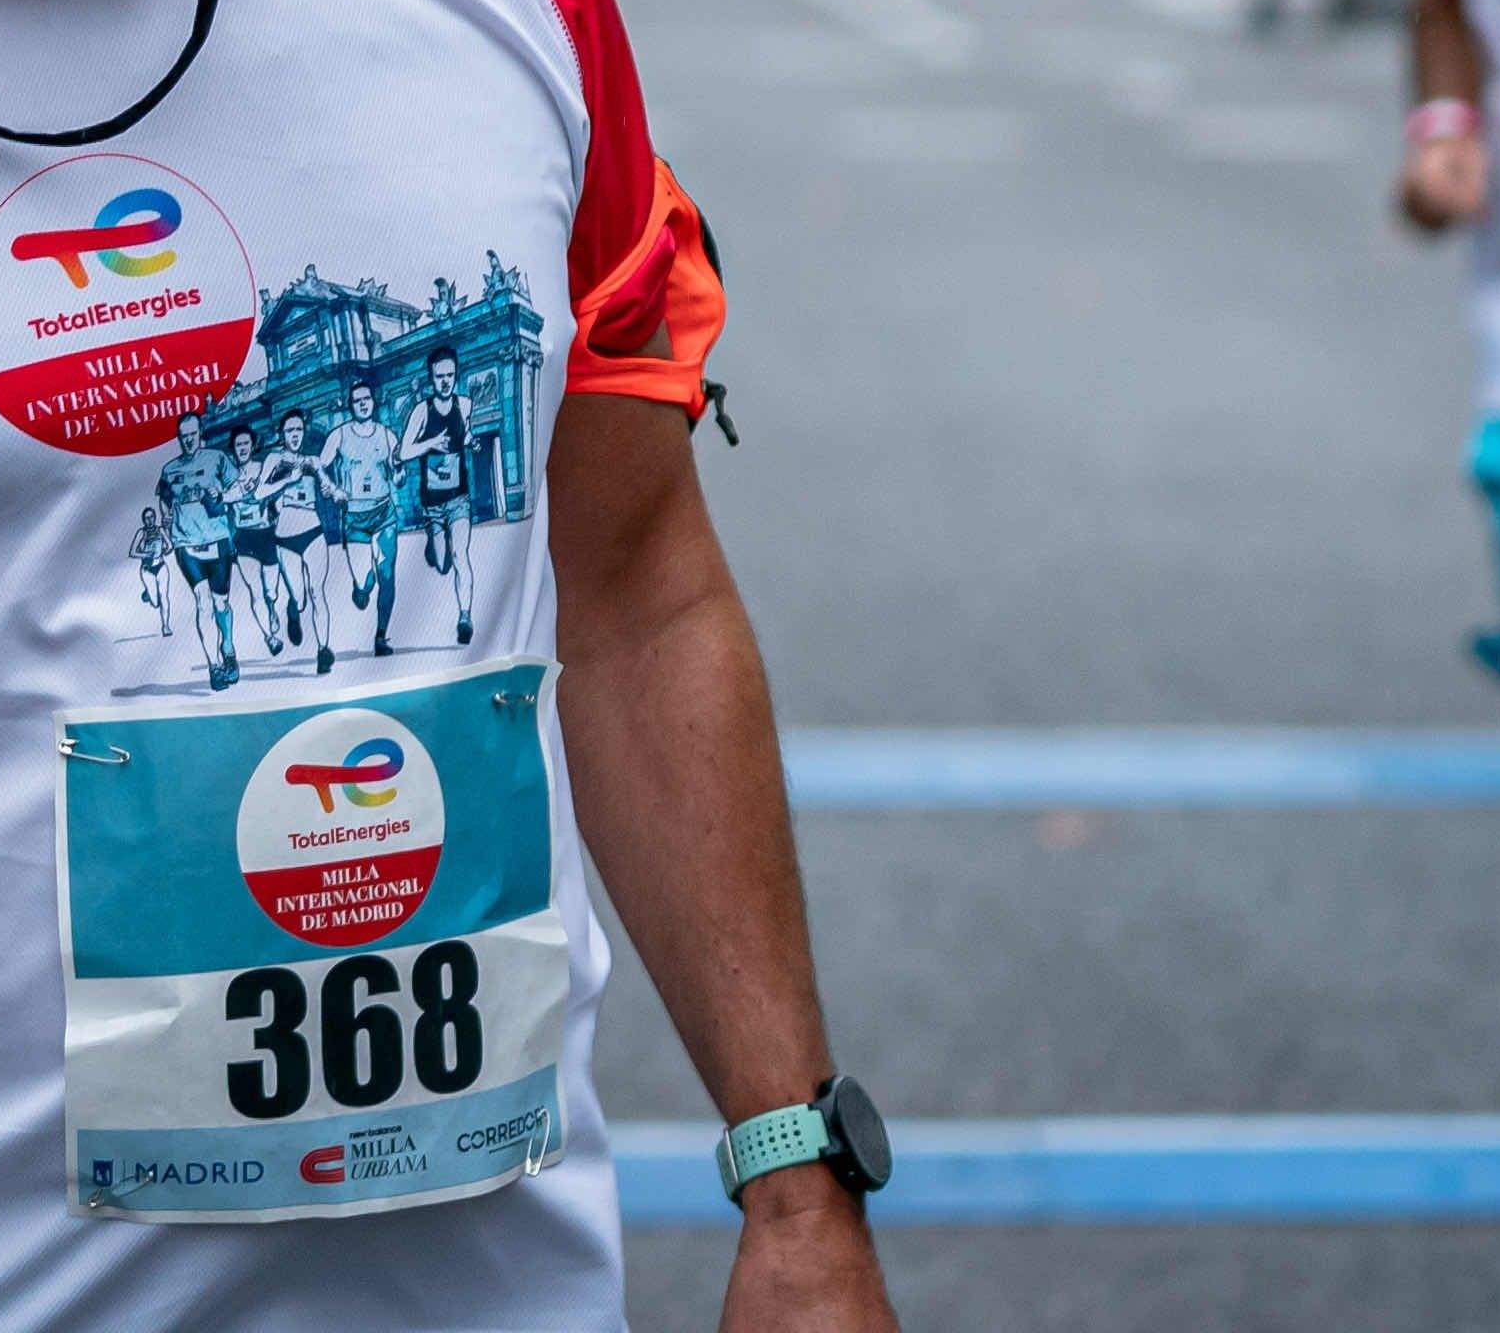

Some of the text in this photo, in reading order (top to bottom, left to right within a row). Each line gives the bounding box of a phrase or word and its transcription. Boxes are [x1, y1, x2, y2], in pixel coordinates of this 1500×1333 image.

[27, 288, 202, 340] TotalEnergies
[83, 346, 164, 380] MILLA
[63, 393, 201, 440] DE MADRID
[287, 818, 411, 850] TotalEnergies
[321, 862, 381, 888] MILLA
[301, 900, 405, 932] DE MADRID
[225, 938, 484, 1121] 368
[350, 1133, 417, 1159] MILLA
[134, 1160, 265, 1185] MADRID
[350, 1153, 428, 1181] URBANA
